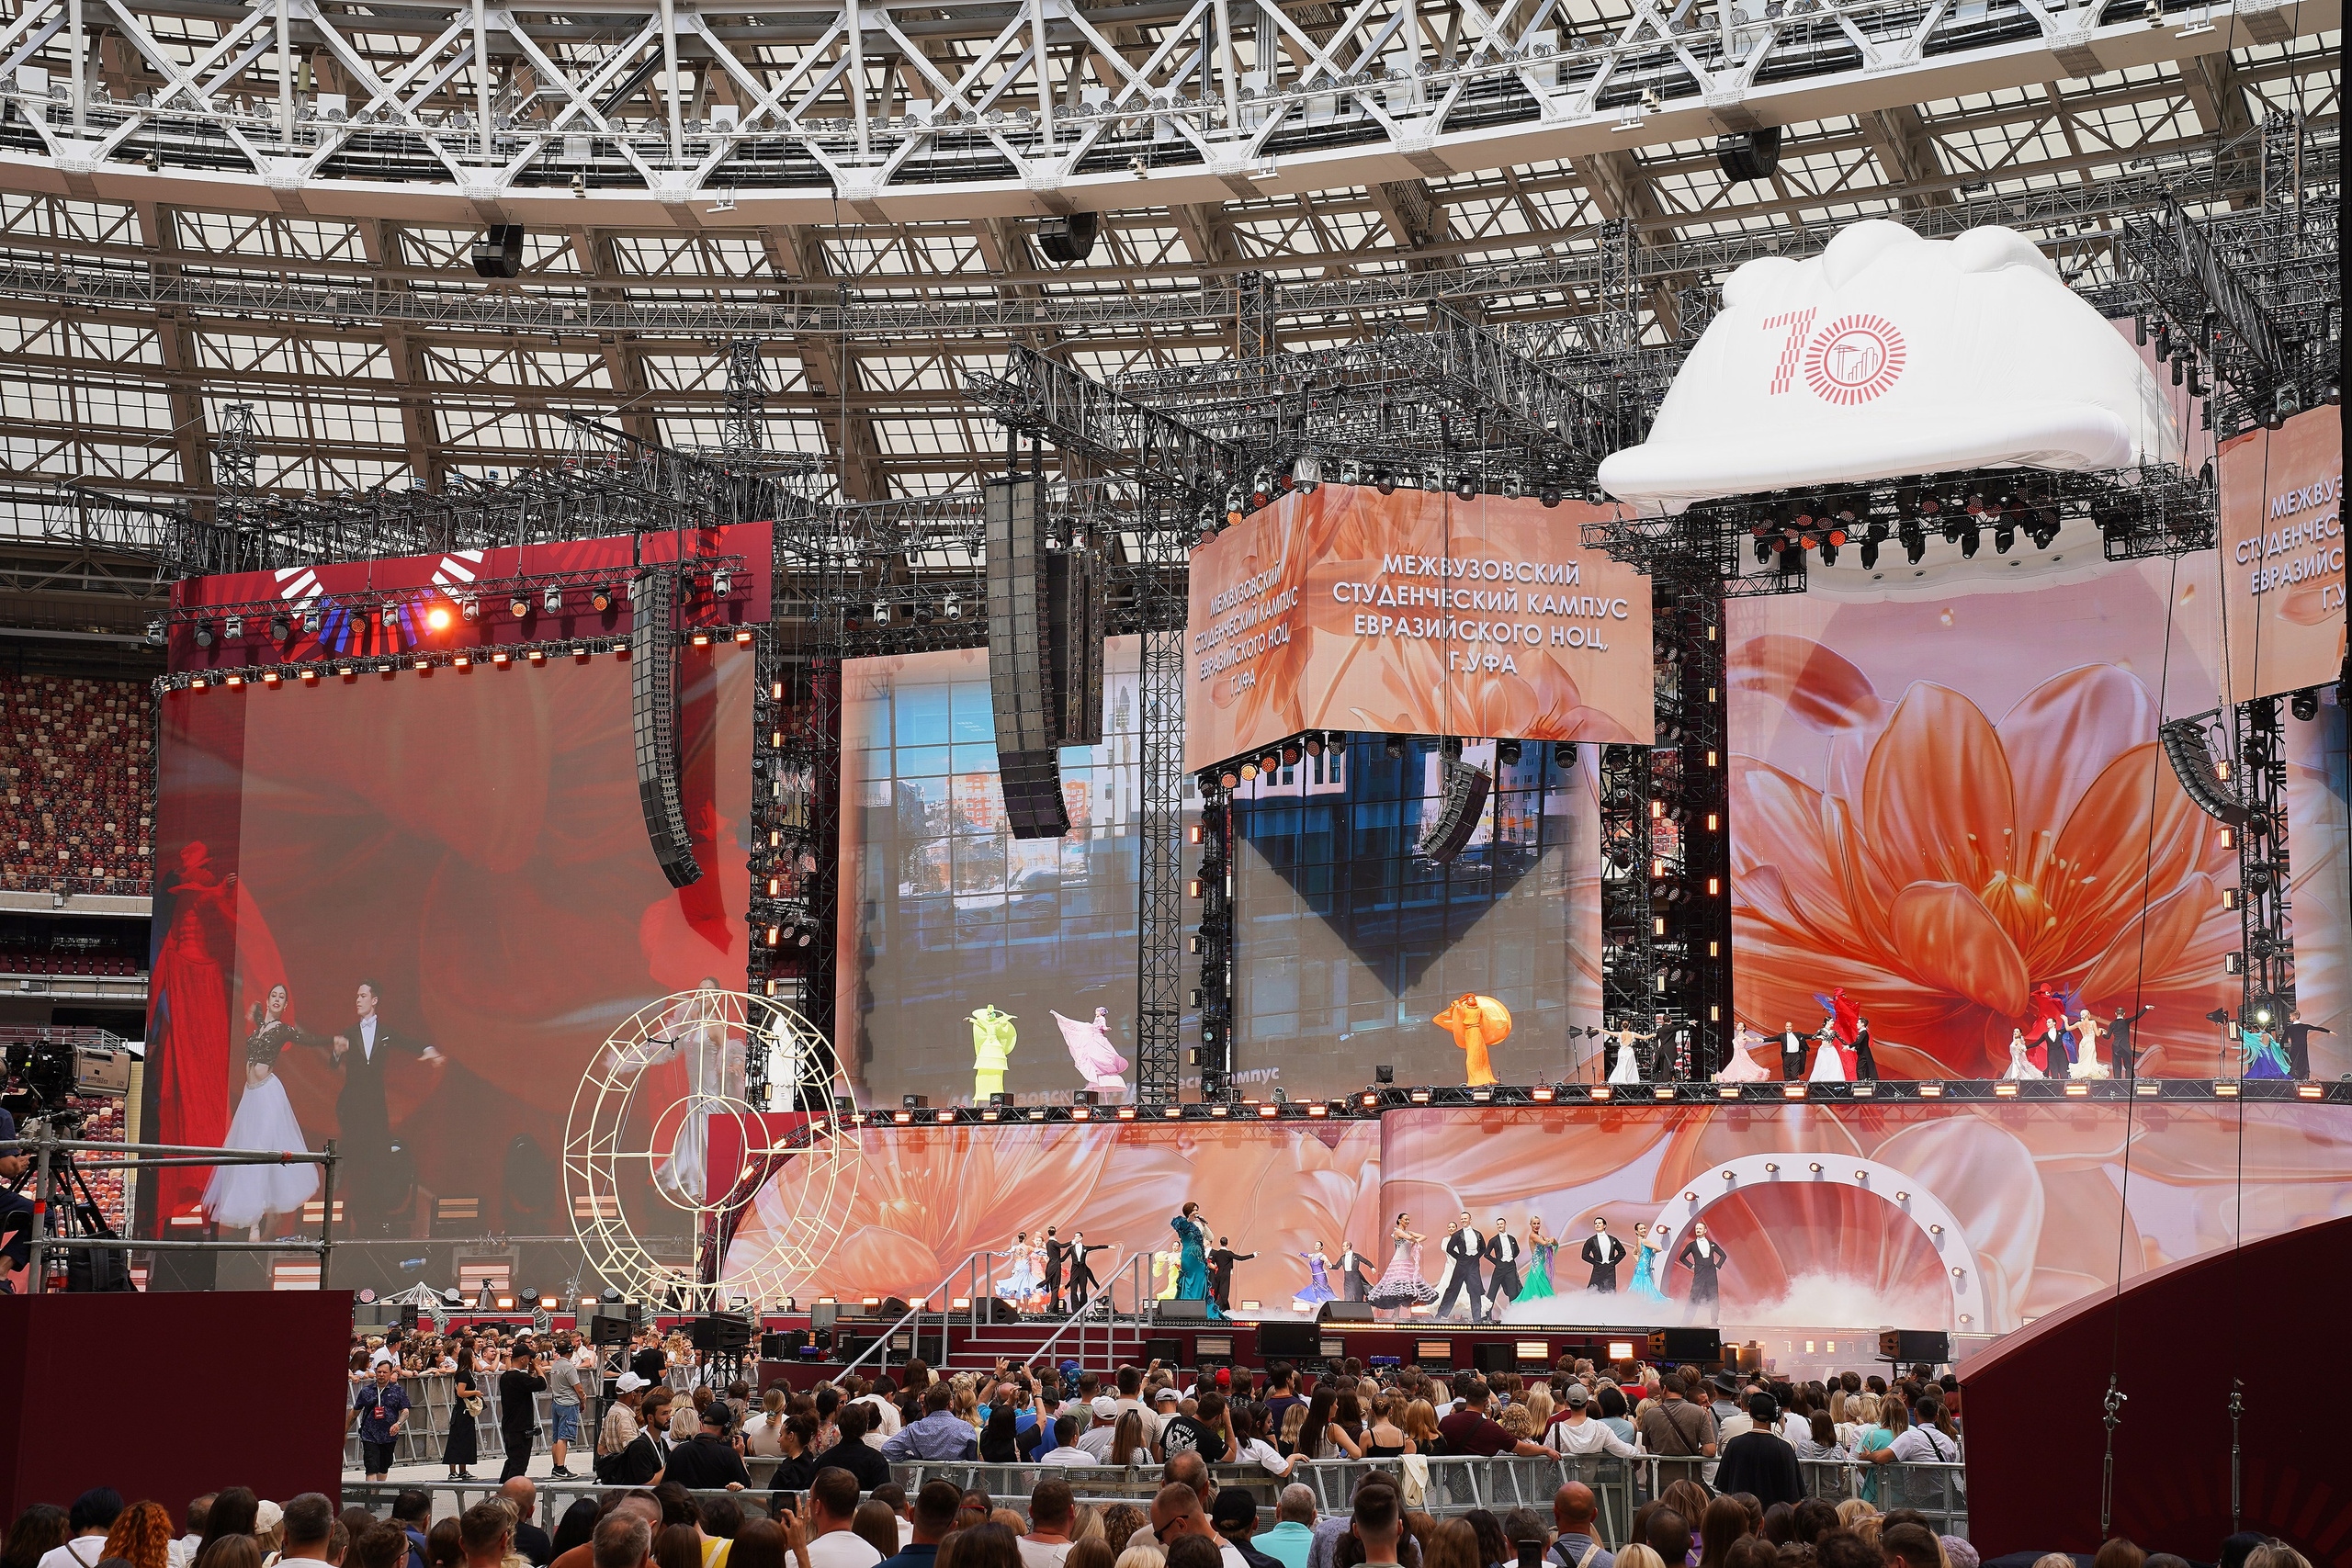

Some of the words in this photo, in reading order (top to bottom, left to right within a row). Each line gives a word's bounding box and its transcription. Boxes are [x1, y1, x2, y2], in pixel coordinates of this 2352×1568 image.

[2235, 513, 2344, 562] СТУДЕНЧЕС
[1382, 553, 1579, 585] МЕЖВУЗОВСКИЙ
[1210, 559, 1281, 616] МЕЖВУЗОВСКИЙ
[1332, 581, 1518, 612] СТУДЕНЧЕСКИЙ
[1527, 592, 1628, 618] КАМПУС
[1194, 602, 1258, 654] СТУДЕНЧЕСКИЙ
[1260, 586, 1298, 622] КАМПУС
[1354, 614, 1543, 643] ЕВРАЗИЙСКОГО
[1551, 626, 1608, 650] НОЦ,
[1200, 632, 1266, 680] ЕВРАЗИЙСКОГО
[1450, 650, 1517, 674] Г.УФА
[1230, 668, 1256, 696] Г.УФА
[1175, 1424, 1194, 1438] RUSSIA
